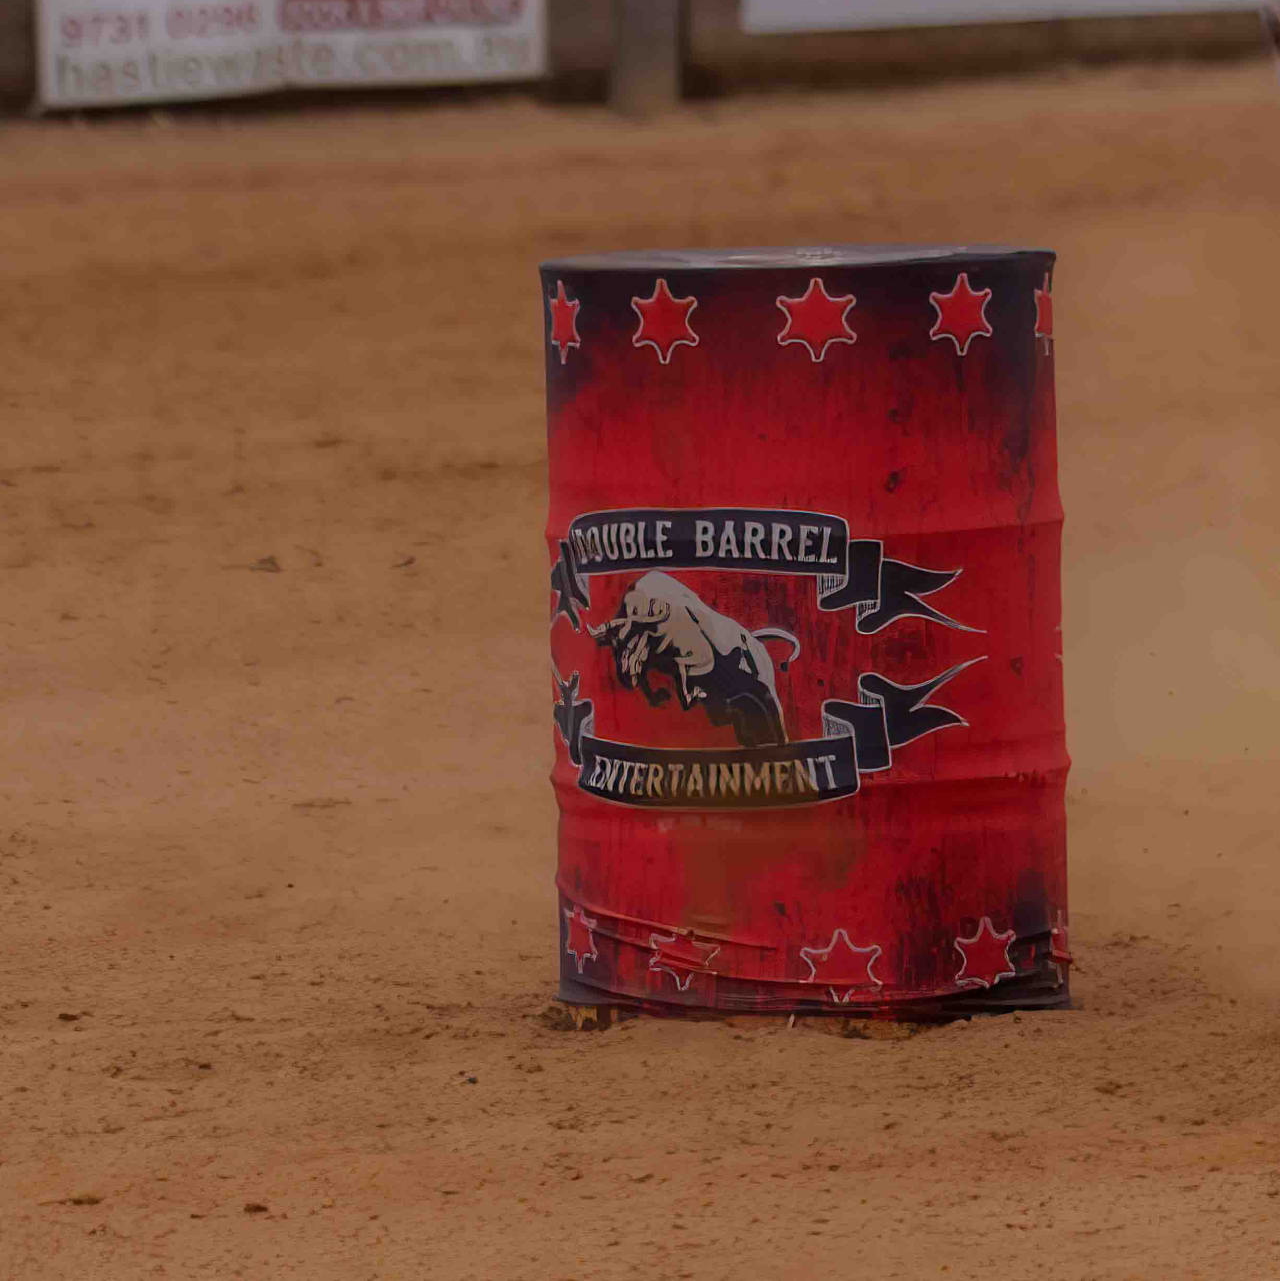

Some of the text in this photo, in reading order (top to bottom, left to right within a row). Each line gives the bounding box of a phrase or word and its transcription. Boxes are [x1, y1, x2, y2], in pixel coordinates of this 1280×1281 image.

[571, 520, 838, 564] DOUBLE BARREL
[588, 754, 838, 798] ENTERTAINMENT
